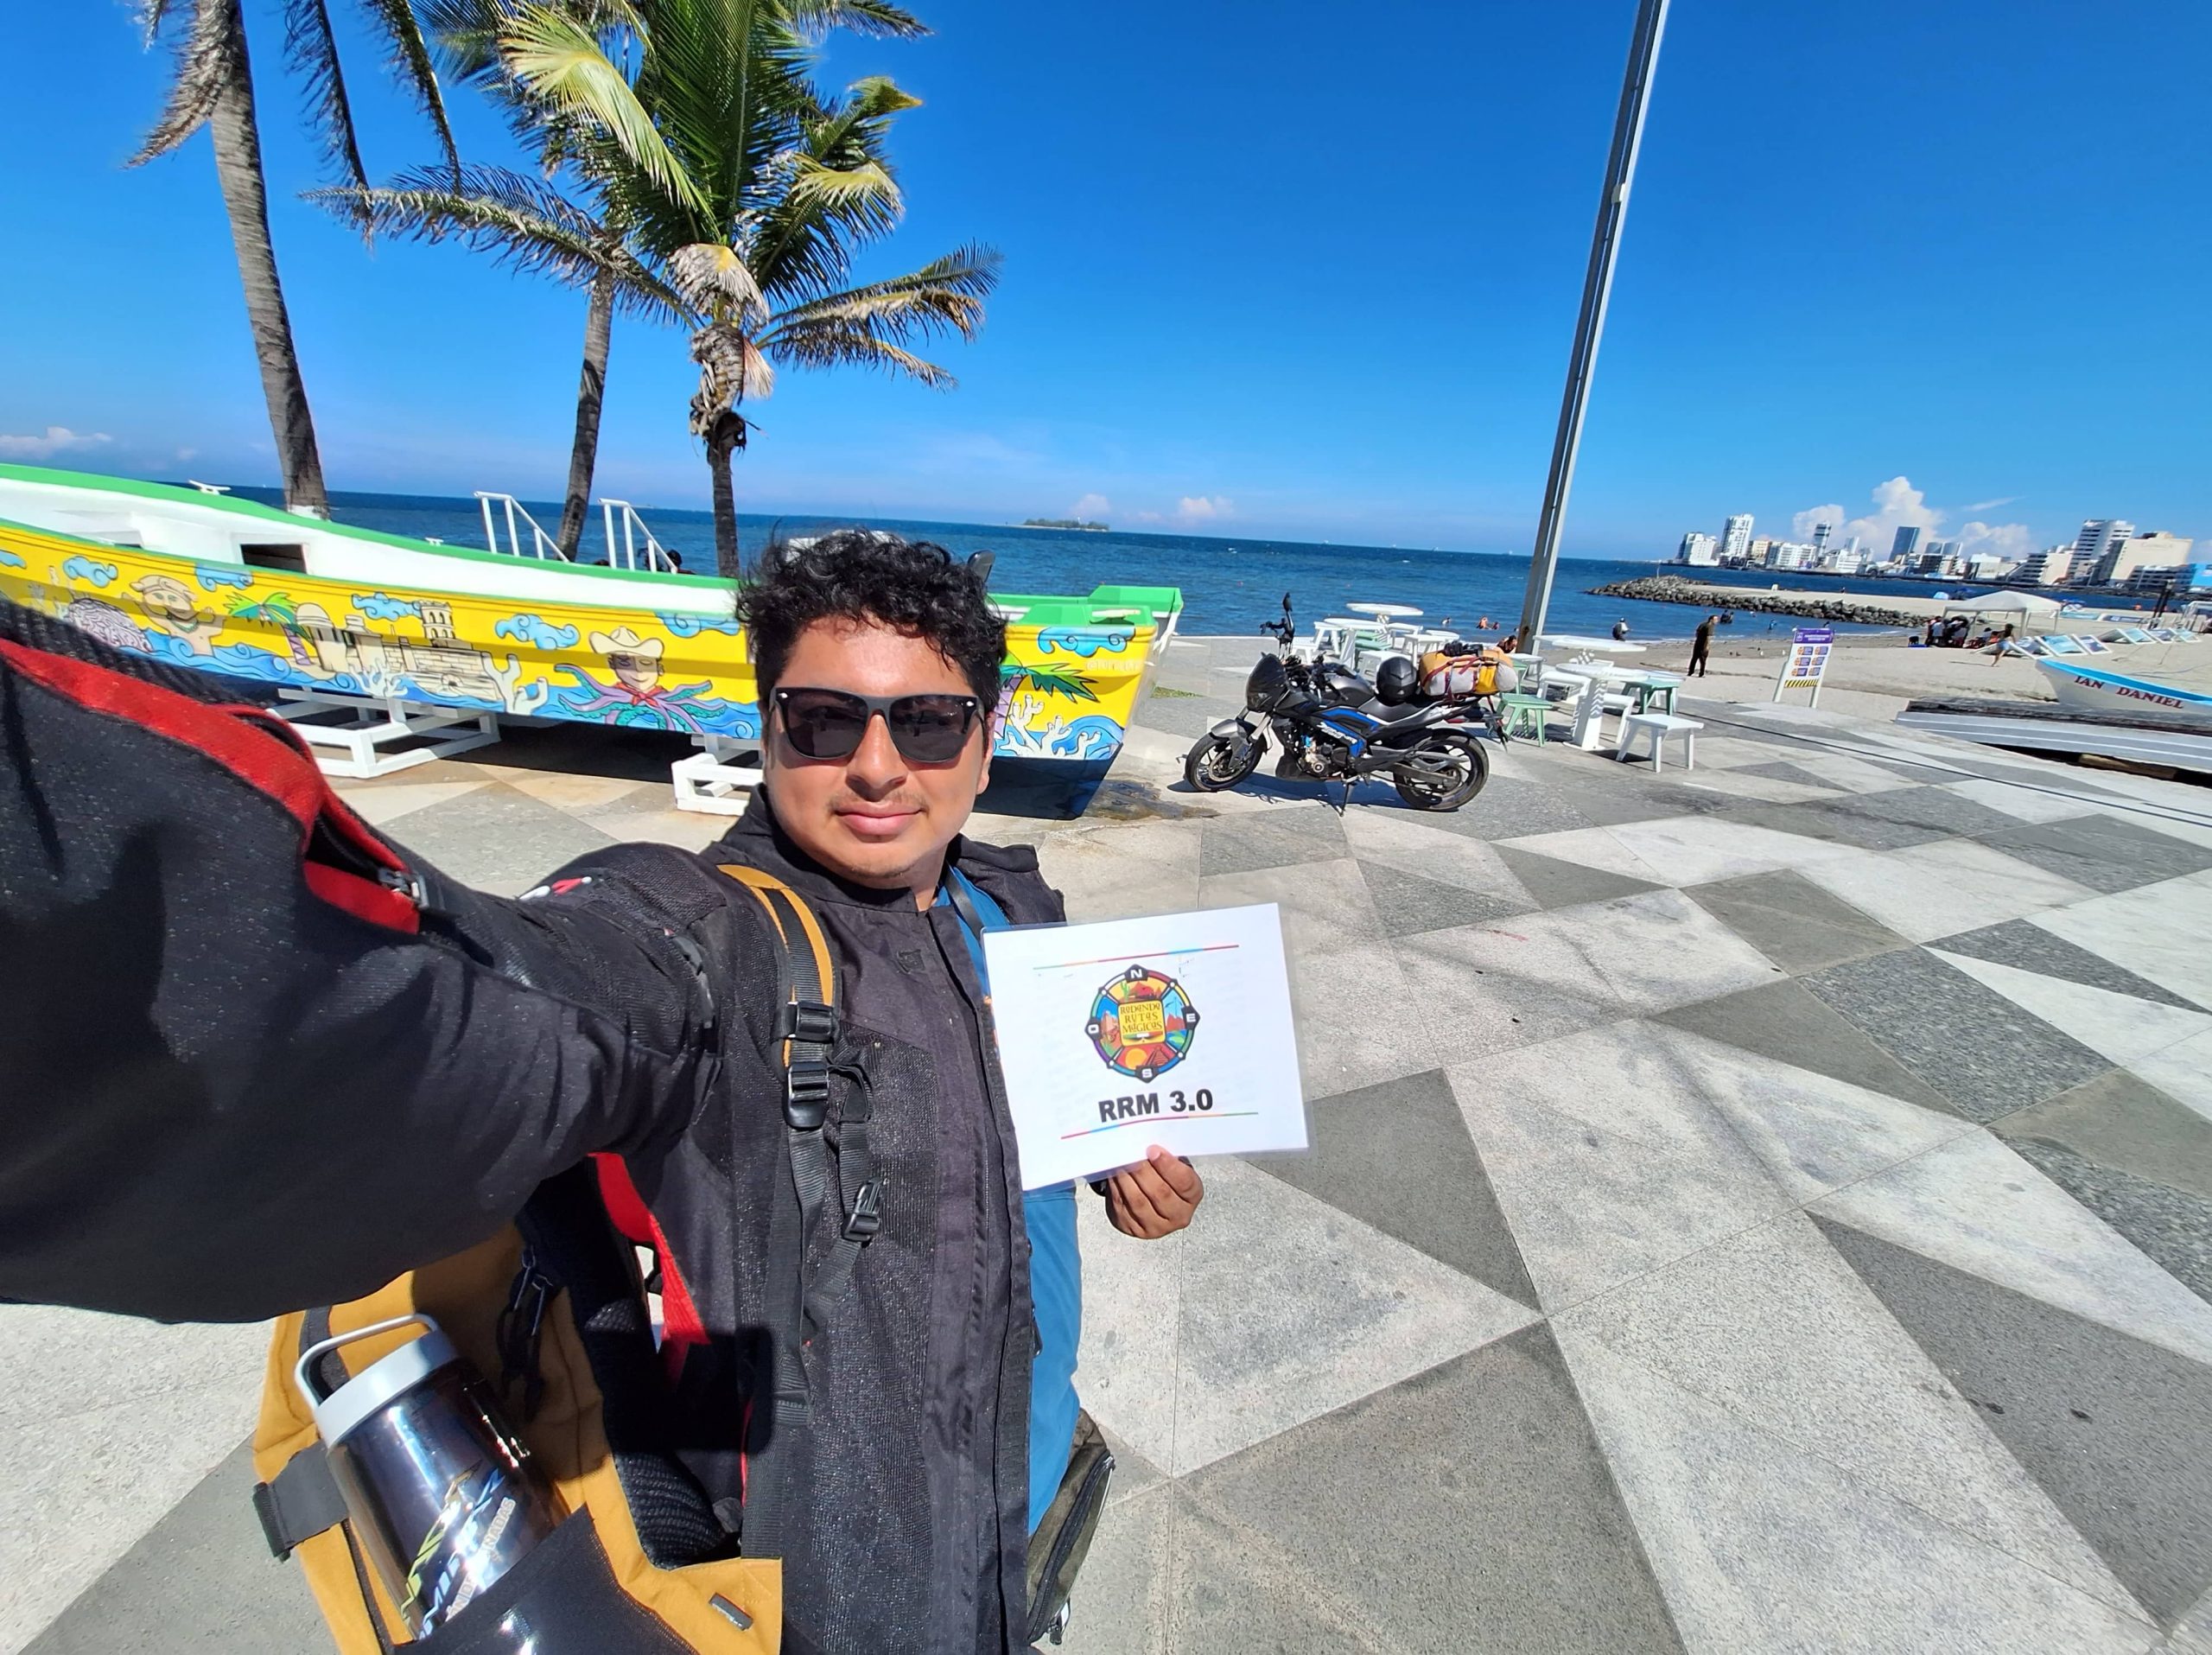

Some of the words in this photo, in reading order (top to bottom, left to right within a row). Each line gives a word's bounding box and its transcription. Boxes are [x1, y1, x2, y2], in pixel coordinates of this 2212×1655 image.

[2074, 675, 2105, 690] IAN
[2115, 686, 2184, 709] DANIEL
[1130, 969, 1143, 978] N
[1098, 1092, 1160, 1123] RRM
[1169, 1089, 1214, 1112] 3.0
